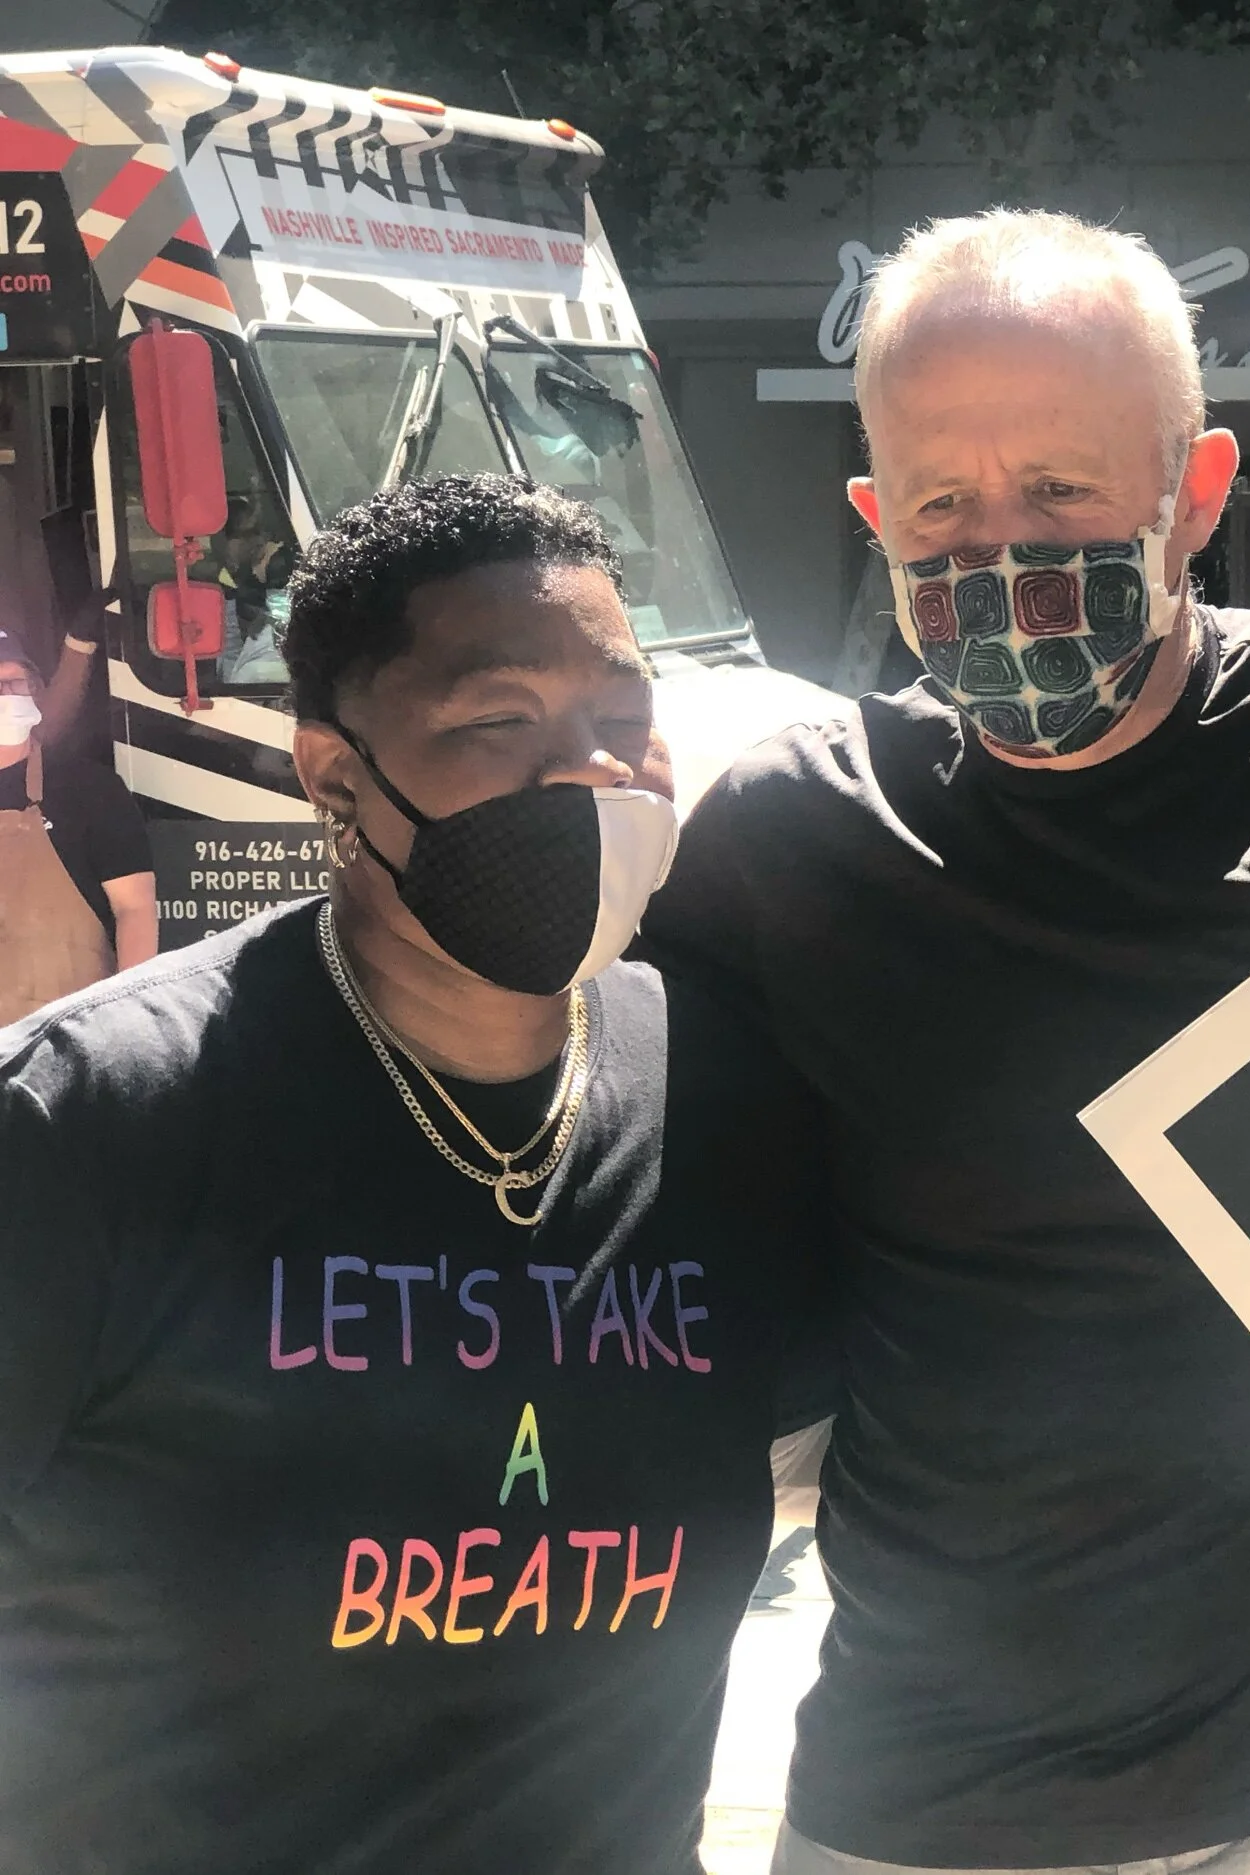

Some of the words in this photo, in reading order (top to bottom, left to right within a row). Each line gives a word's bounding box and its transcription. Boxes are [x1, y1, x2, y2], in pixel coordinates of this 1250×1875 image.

[261, 206, 363, 245] NASHVILLE
[366, 219, 444, 254] INSPIRED
[444, 229, 544, 262] SACRAMENTO
[546, 240, 588, 268] MADE
[190, 871, 281, 890] PROPER
[270, 1255, 500, 1371] LET'S
[527, 1261, 712, 1373] TAKE
[500, 1402, 549, 1506] A
[331, 1525, 684, 1649] BREATH
